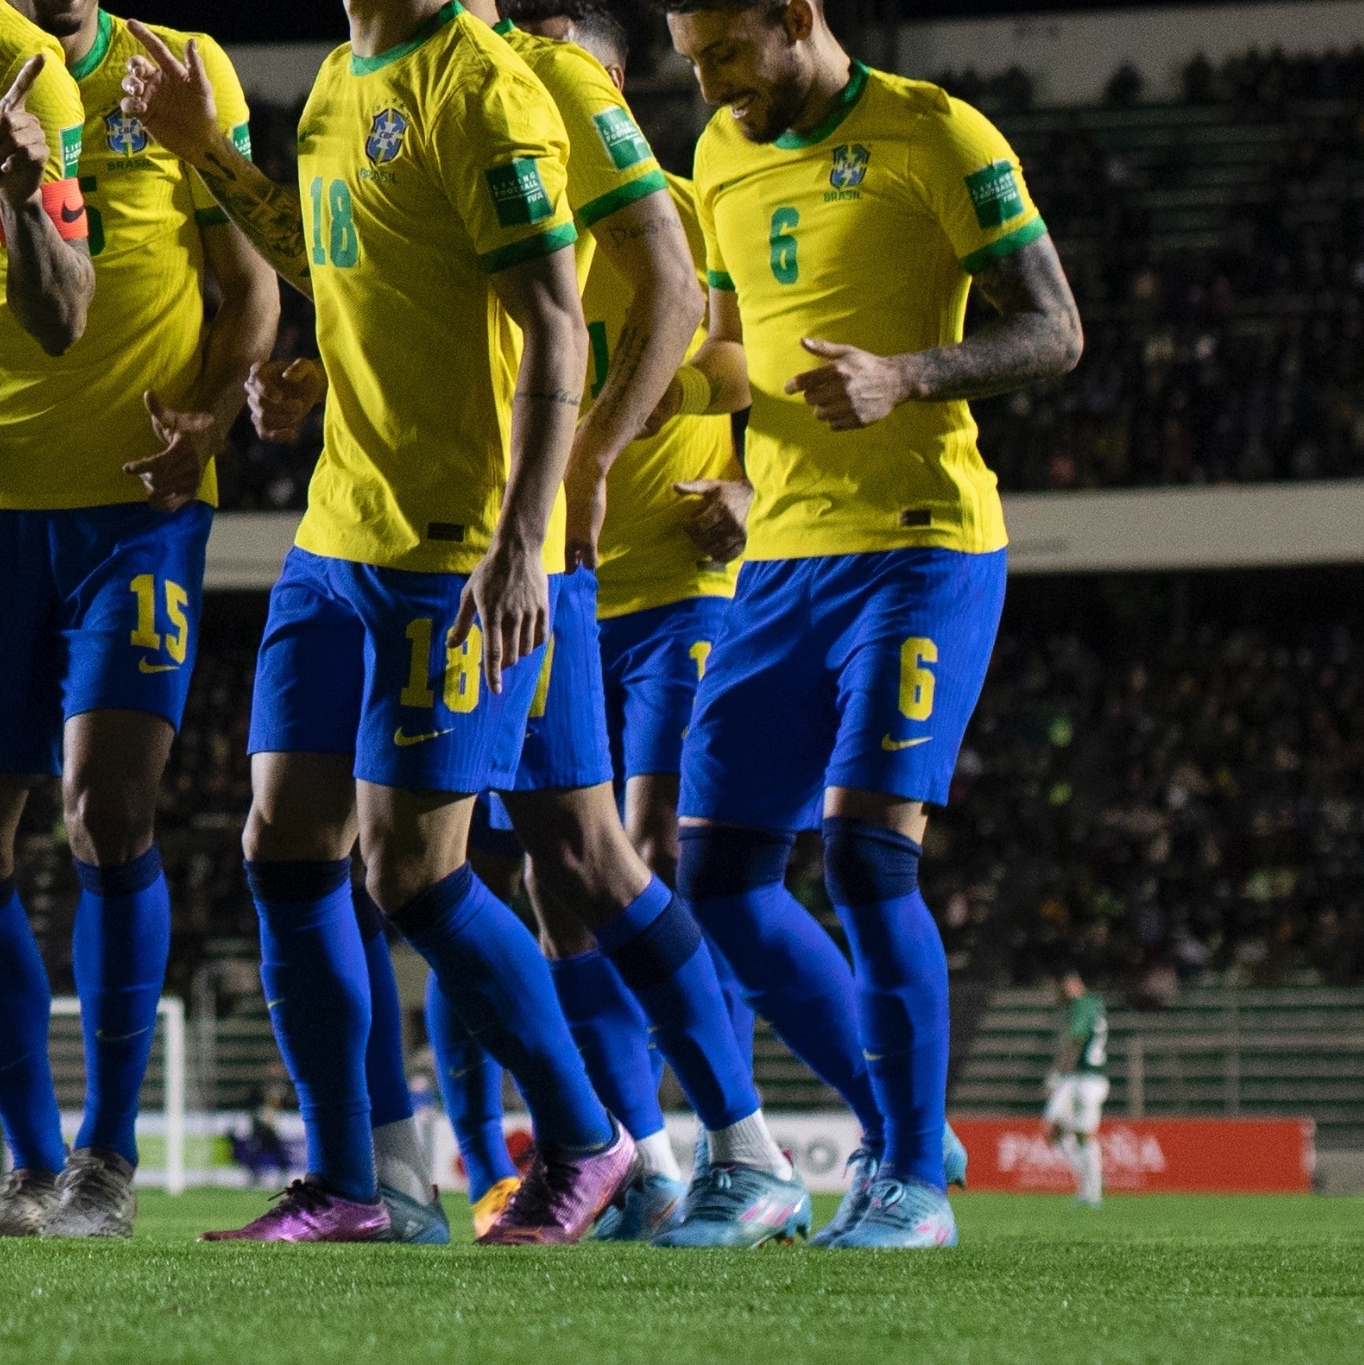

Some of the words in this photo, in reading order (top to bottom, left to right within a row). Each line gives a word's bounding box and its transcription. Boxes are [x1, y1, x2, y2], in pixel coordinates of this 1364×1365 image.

[310, 176, 359, 269] 18
[527, 192, 544, 204] FIFA
[769, 207, 800, 285] 6
[130, 573, 189, 664] 15
[400, 617, 483, 713] 18
[899, 637, 938, 722] 6
